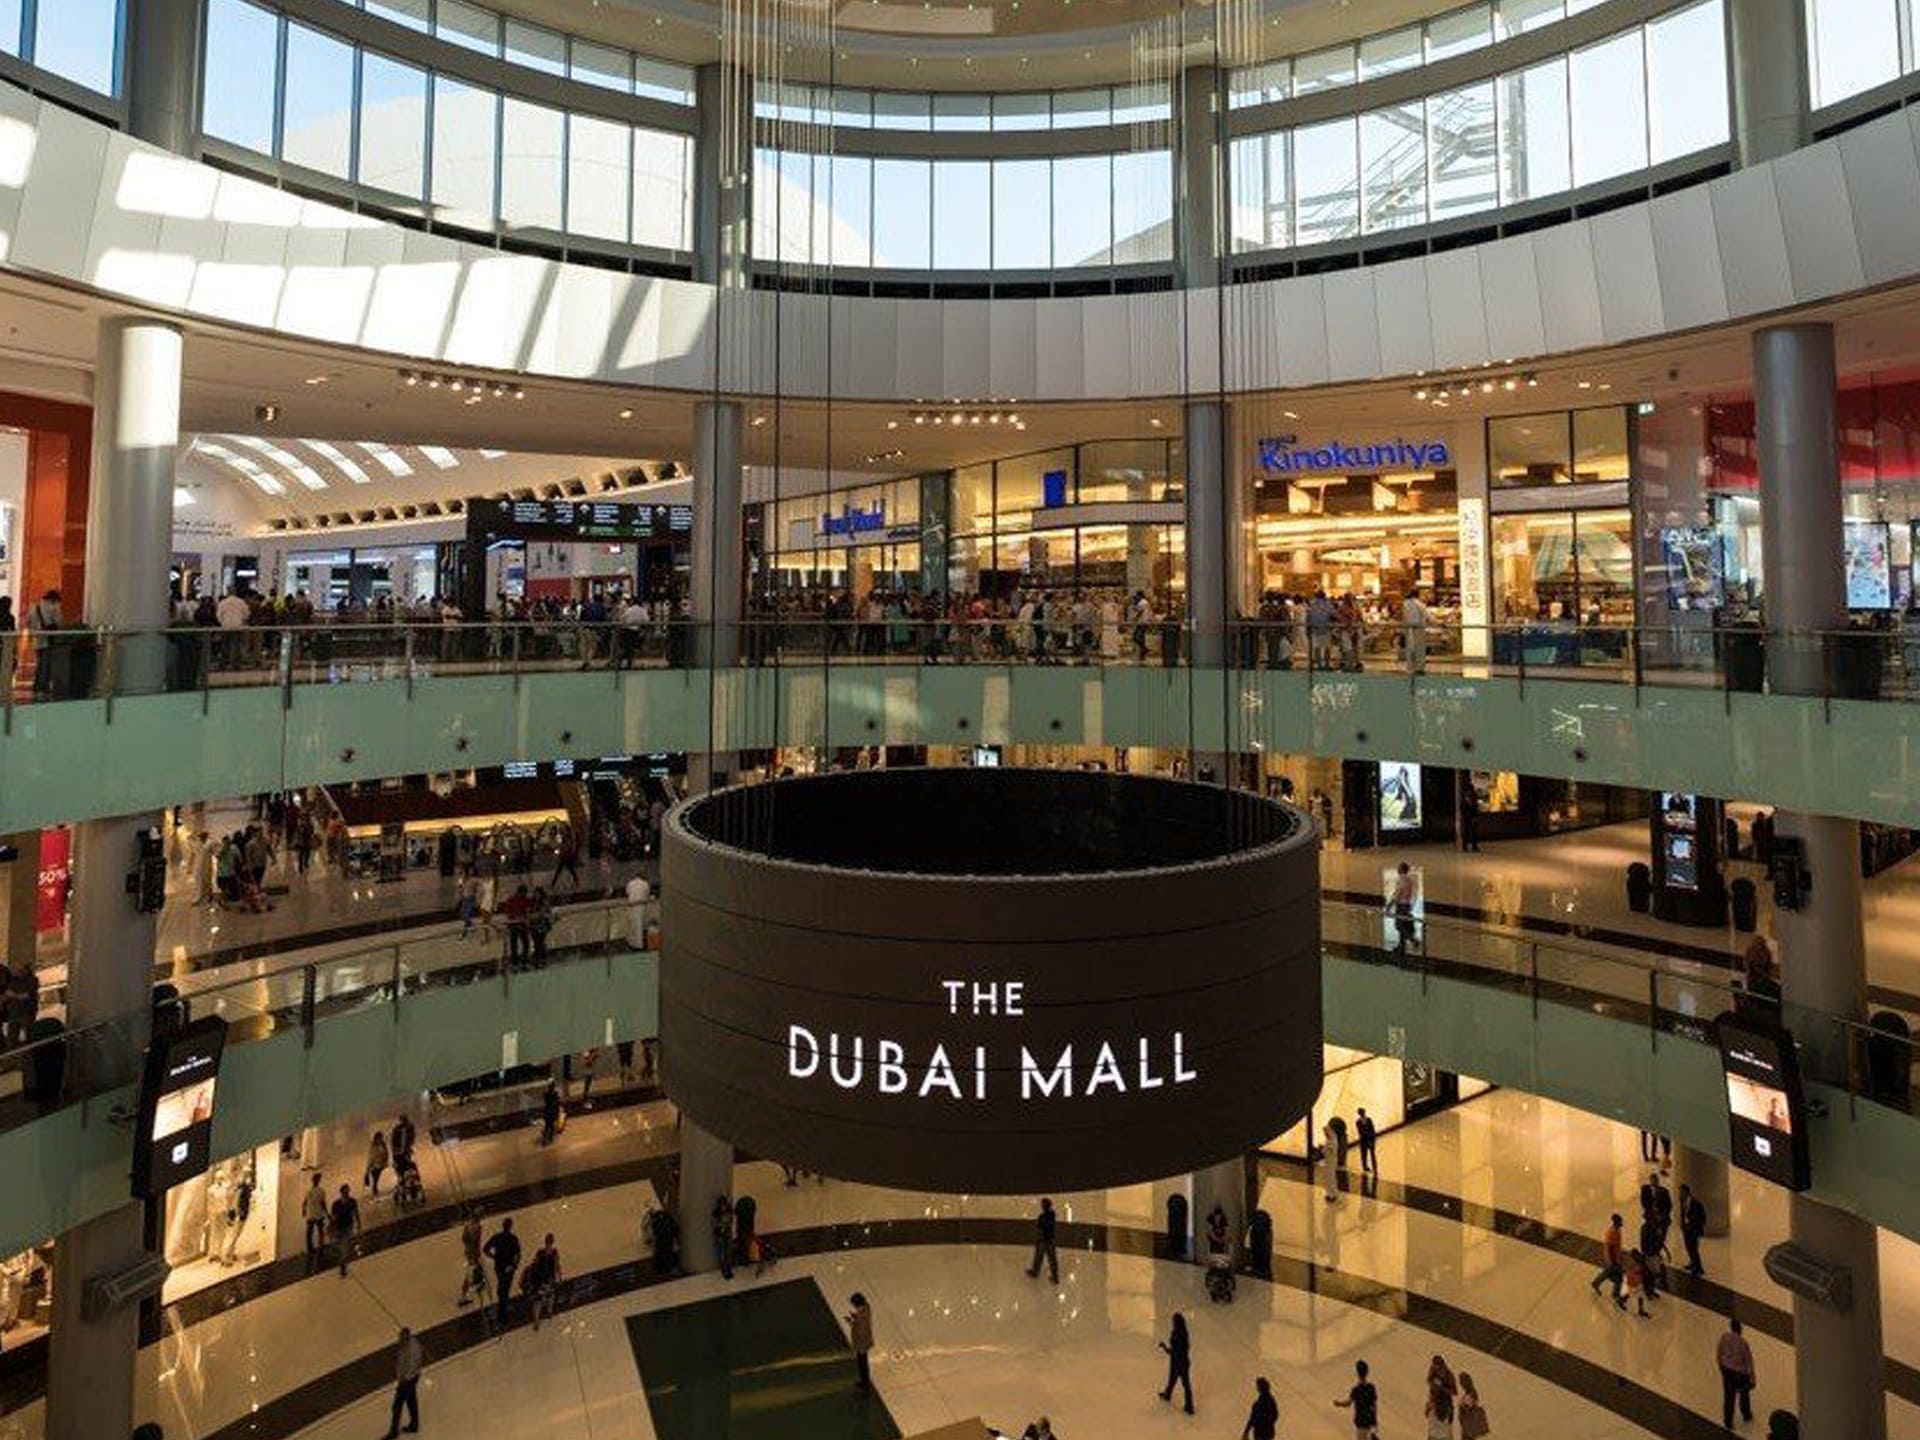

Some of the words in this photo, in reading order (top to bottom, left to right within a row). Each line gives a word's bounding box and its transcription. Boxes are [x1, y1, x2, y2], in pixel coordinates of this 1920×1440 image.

[1260, 438, 1448, 470] Kinokuniya
[942, 981, 1024, 1015] THE
[788, 1024, 985, 1100] DUBAI
[1021, 1032, 1197, 1100] MALL
